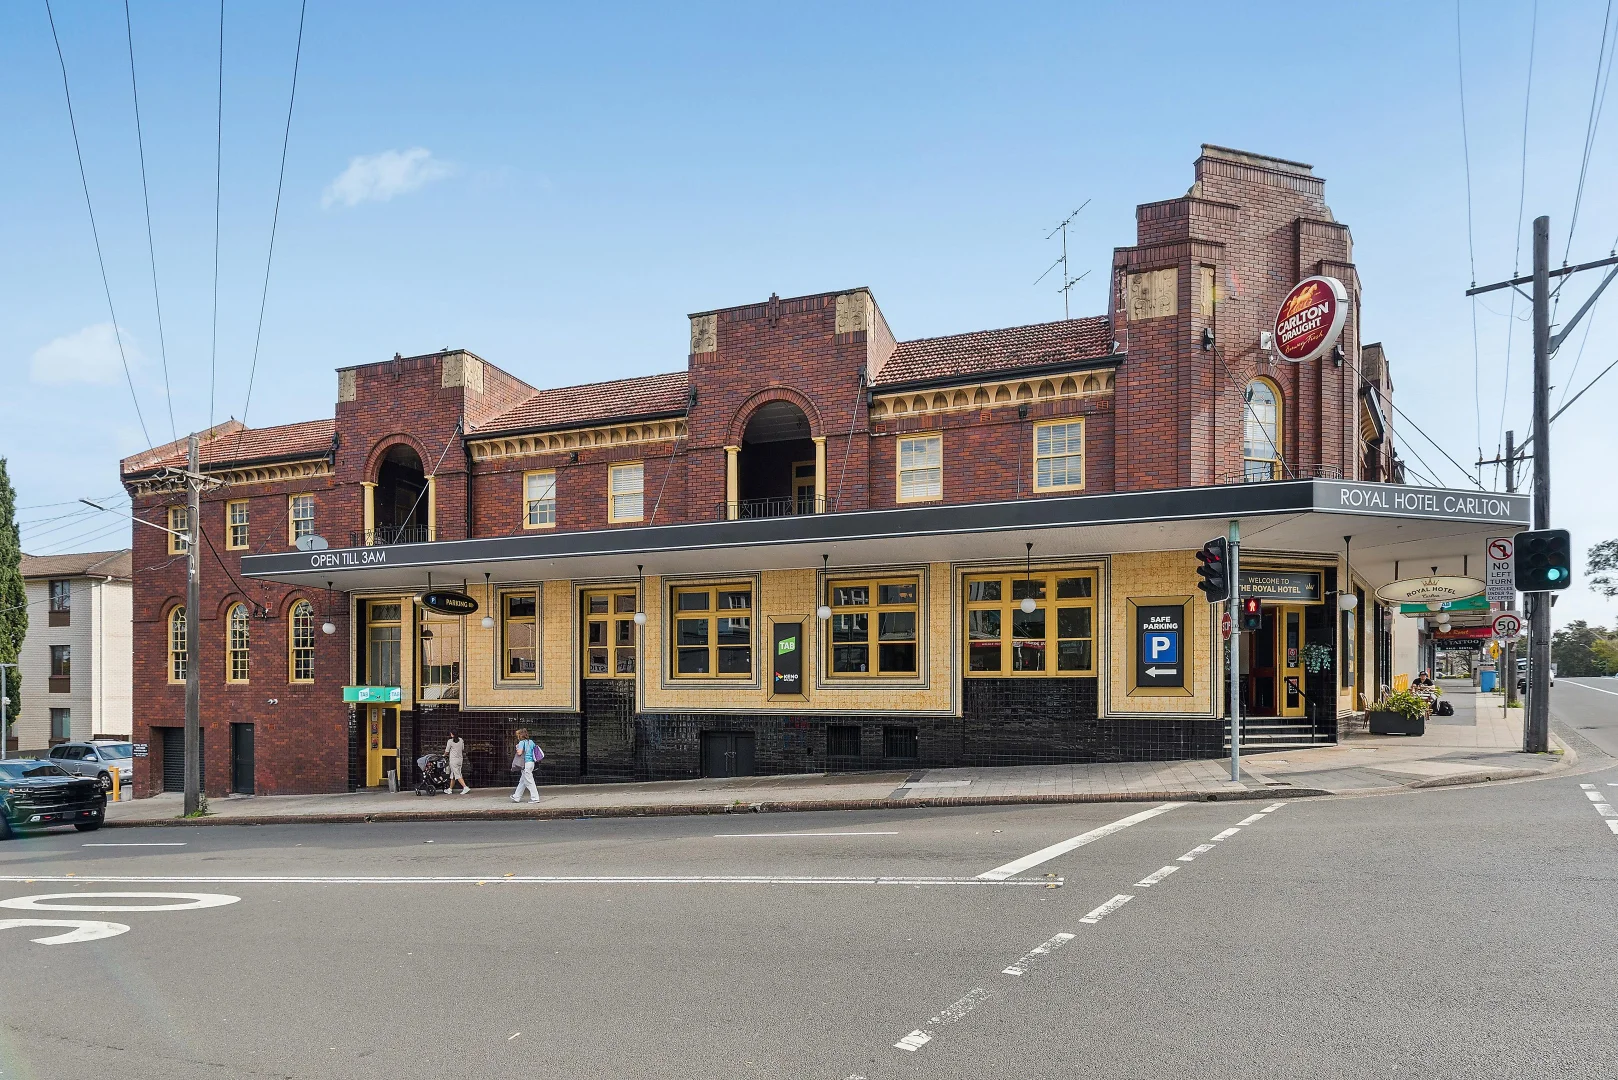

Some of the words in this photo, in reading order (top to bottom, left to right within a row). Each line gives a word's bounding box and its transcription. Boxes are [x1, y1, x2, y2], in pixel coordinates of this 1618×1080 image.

[1277, 302, 1329, 335] CARLTON
[1282, 317, 1322, 343] DRAUGHT
[1340, 488, 1389, 508] ROYAL
[1394, 492, 1440, 512] HOTEL
[1443, 496, 1510, 516] CARLTON
[310, 553, 340, 567] OPEN
[342, 552, 360, 565] TILL
[361, 550, 386, 564] 3AM
[1493, 562, 1510, 570] NO
[1248, 577, 1280, 585] WELCOME
[1252, 585, 1276, 593] ROYAL
[1277, 586, 1301, 594] HOTEL
[1406, 587, 1431, 598] ROYAL
[1432, 586, 1456, 595] HOTEL
[445, 598, 468, 608] PARKING
[1498, 620, 1516, 631] 50
[780, 641, 795, 650] TAB
[1151, 636, 1171, 659] P
